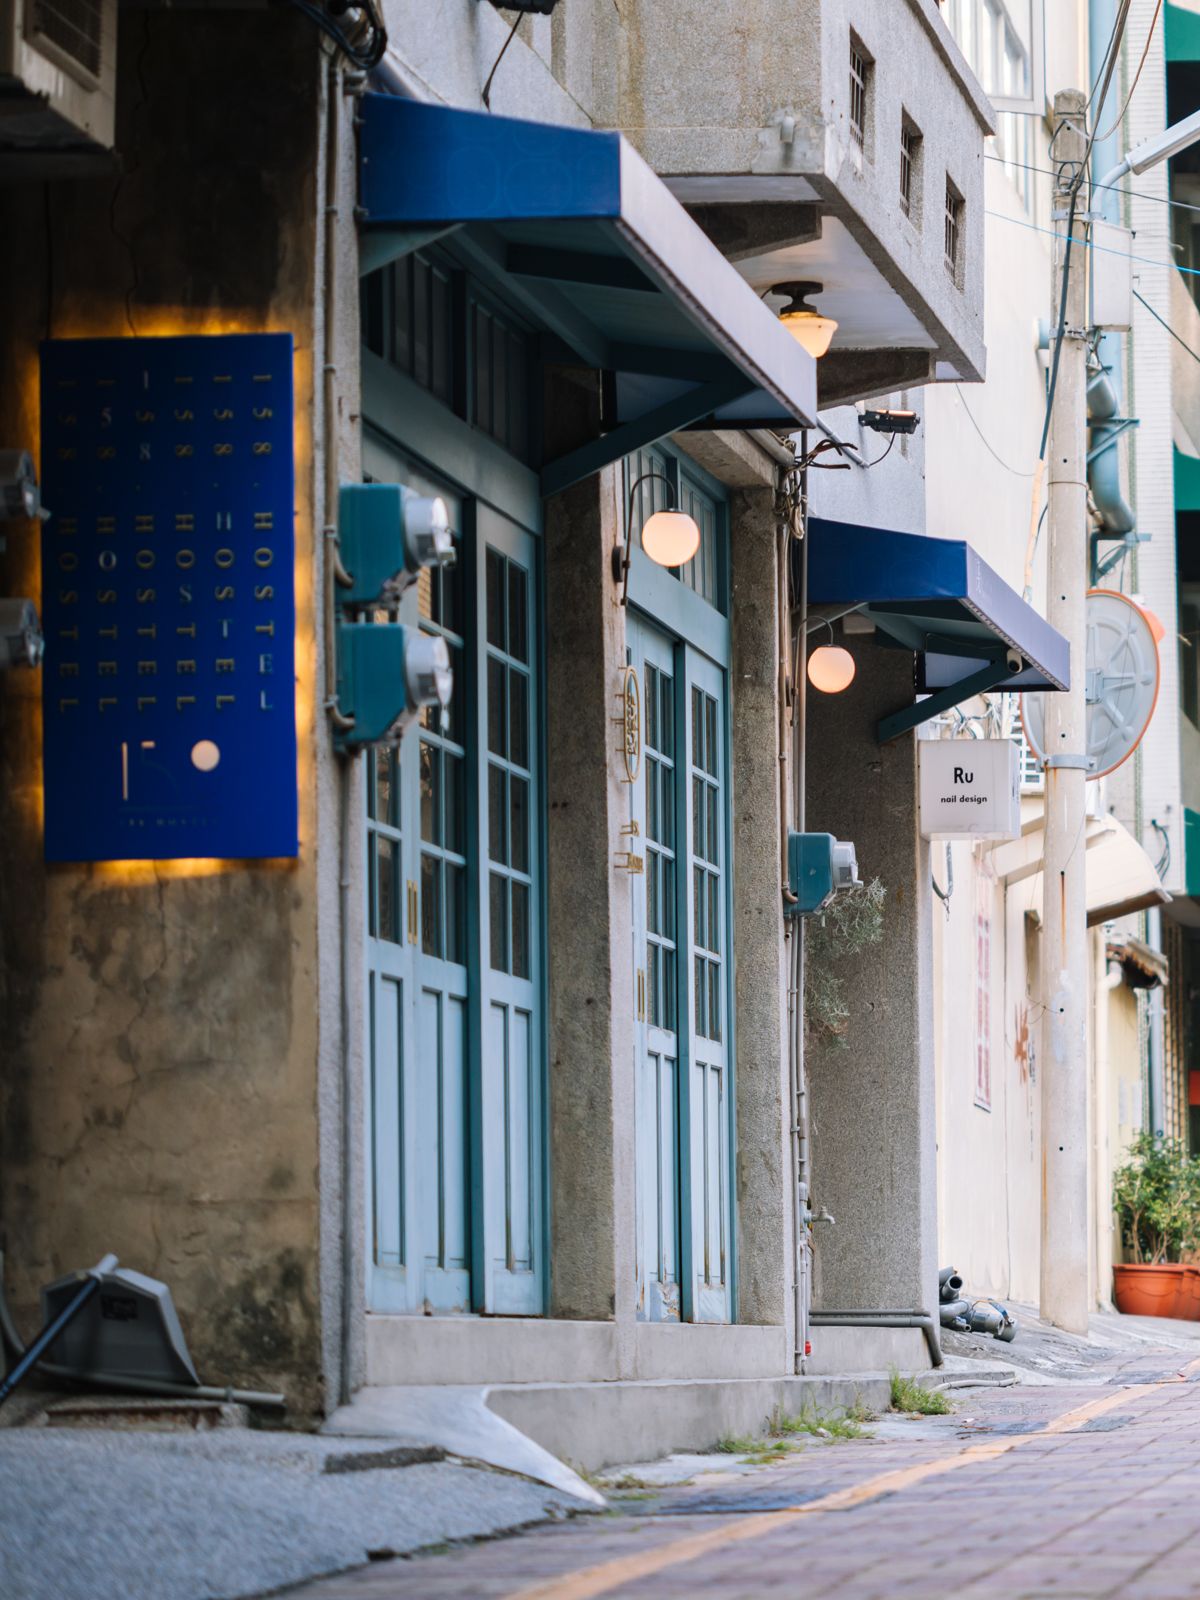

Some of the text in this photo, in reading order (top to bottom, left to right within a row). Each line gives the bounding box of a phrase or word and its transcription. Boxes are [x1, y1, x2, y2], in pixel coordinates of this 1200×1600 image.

[954, 767, 974, 784] Ru
[940, 795, 988, 805] nail design
